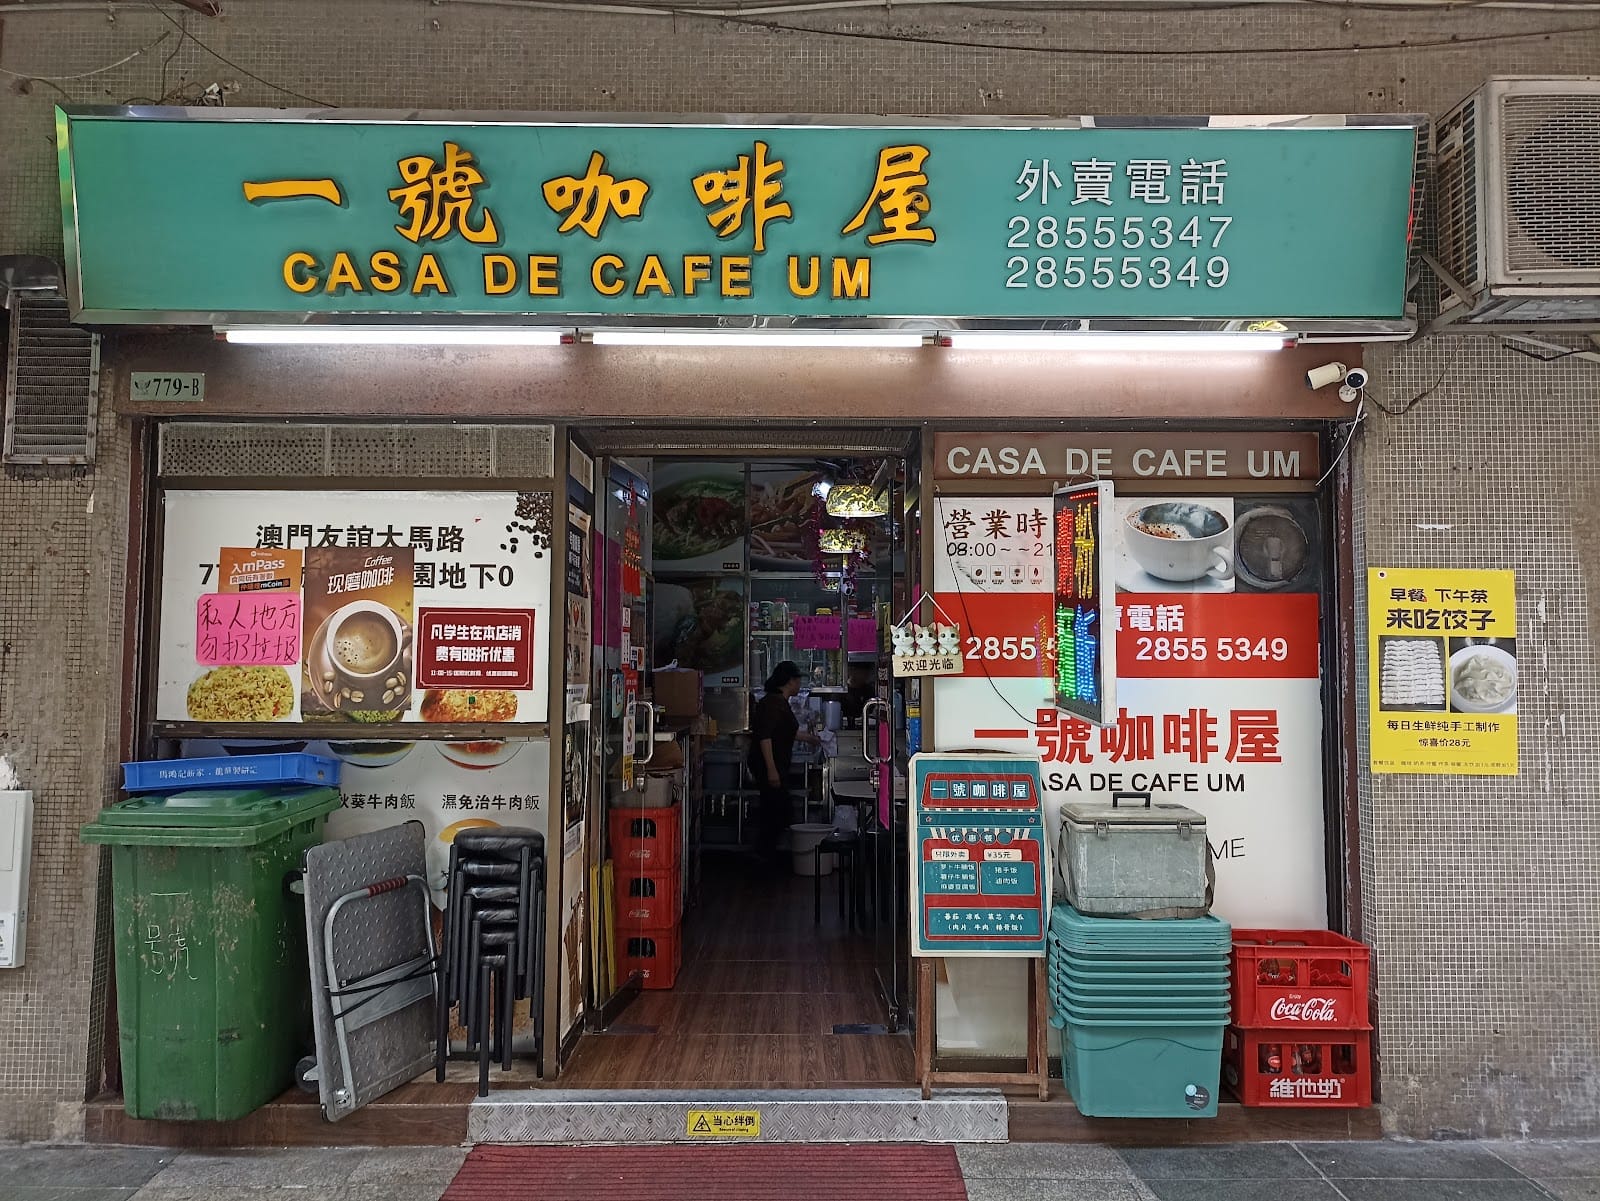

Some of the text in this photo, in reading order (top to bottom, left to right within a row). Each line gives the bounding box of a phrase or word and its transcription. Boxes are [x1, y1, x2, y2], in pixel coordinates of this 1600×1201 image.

[1016, 158, 1228, 205] 外賣電話
[243, 141, 936, 252] 一號咖啡屋
[1007, 215, 1233, 249] 28555347
[283, 252, 871, 298] CASA DE CAFE UM
[1006, 256, 1231, 289] 28555349
[153, 378, 199, 396] 779-B
[947, 447, 1301, 478] CASA DE CAFE UM
[945, 508, 1048, 540] 營業時
[256, 524, 465, 553] 澳門友誼大馬路
[364, 555, 393, 568] Coffee
[327, 567, 395, 594] 现磨咖啡
[200, 599, 297, 631] 私人地方
[1386, 608, 1496, 631] 来吃饺子
[430, 624, 522, 641] 凡学生在本店消
[966, 636, 1037, 660] 2855
[1136, 637, 1288, 661] 2855 5349
[902, 658, 954, 672] 欢迎光临
[974, 707, 1282, 764] 一號咖啡屋
[1387, 720, 1500, 732] 每日生鲜纯手工制作
[932, 783, 1028, 798] 一號咖啡屋
[1090, 773, 1123, 792] DE
[1131, 773, 1199, 792] CAFE
[1207, 774, 1245, 792] UM
[1270, 998, 1336, 1021] Coca-Cola
[1270, 1078, 1342, 1099] 維他奶
[712, 1115, 755, 1126] 当心绊倒
